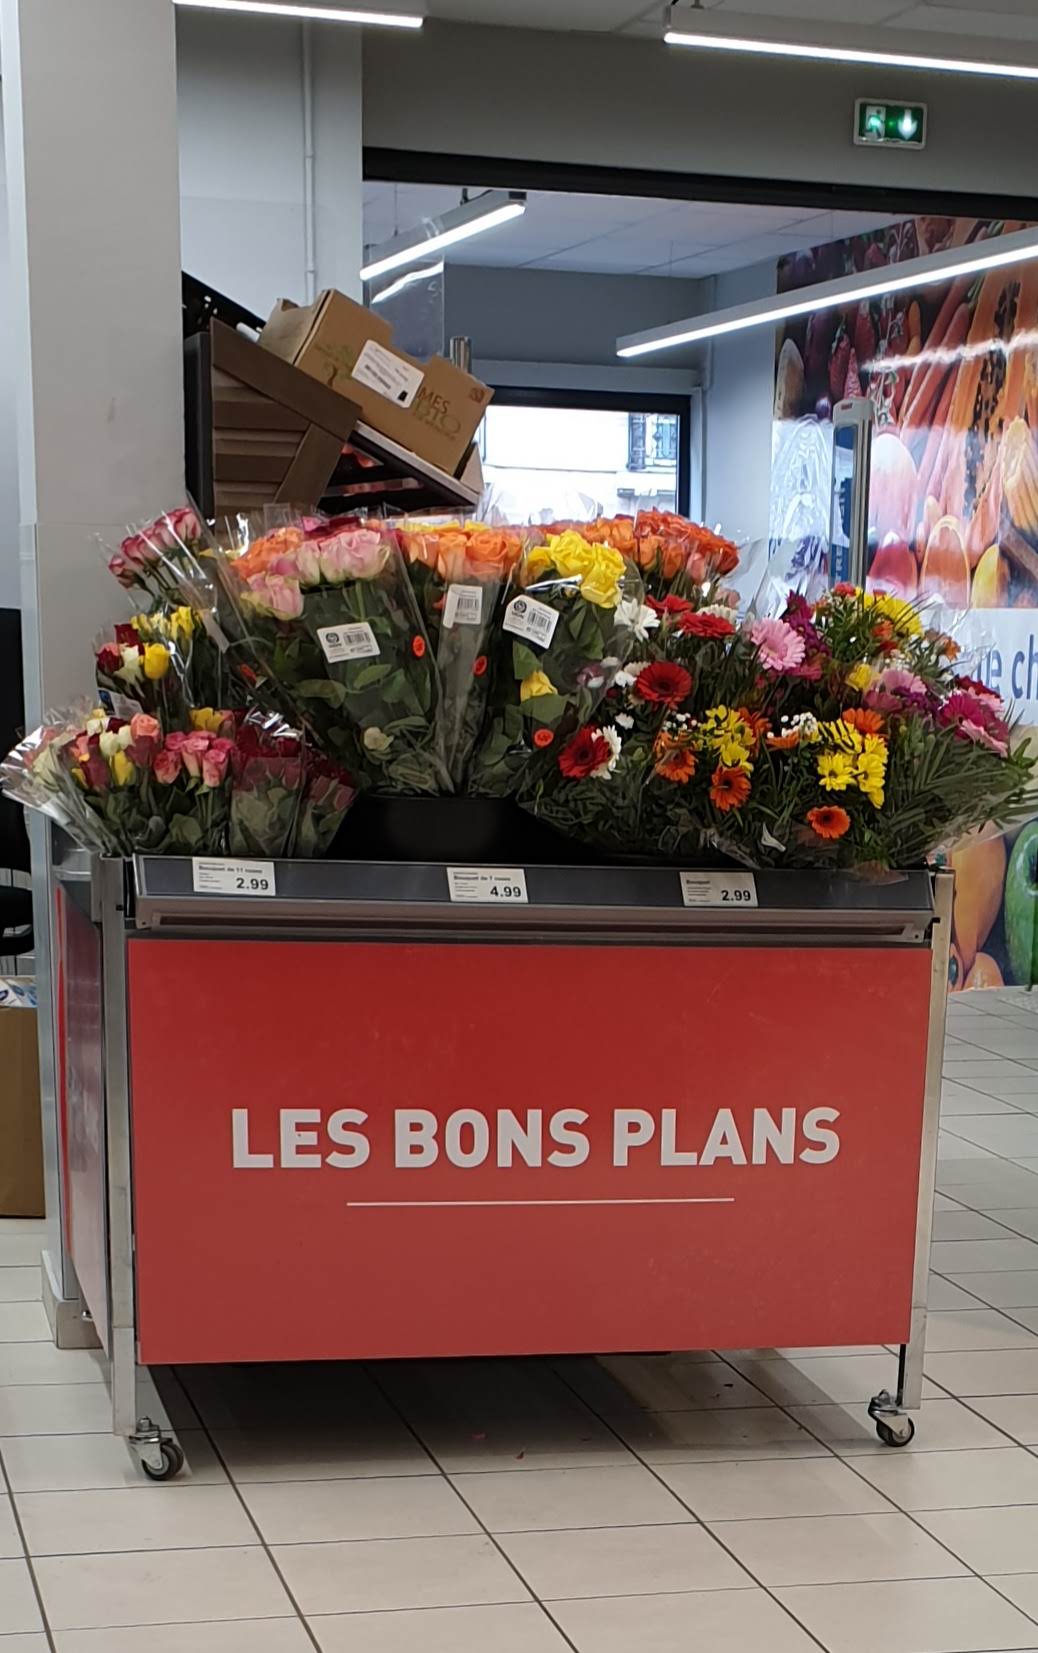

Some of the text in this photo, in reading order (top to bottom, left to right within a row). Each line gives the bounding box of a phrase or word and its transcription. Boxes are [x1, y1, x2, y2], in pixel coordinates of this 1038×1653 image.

[236, 877, 269, 890] 2.99
[490, 885, 522, 898] 4.99
[721, 889, 752, 902] 2.99
[231, 1107, 841, 1169] LES BONS PLANS
